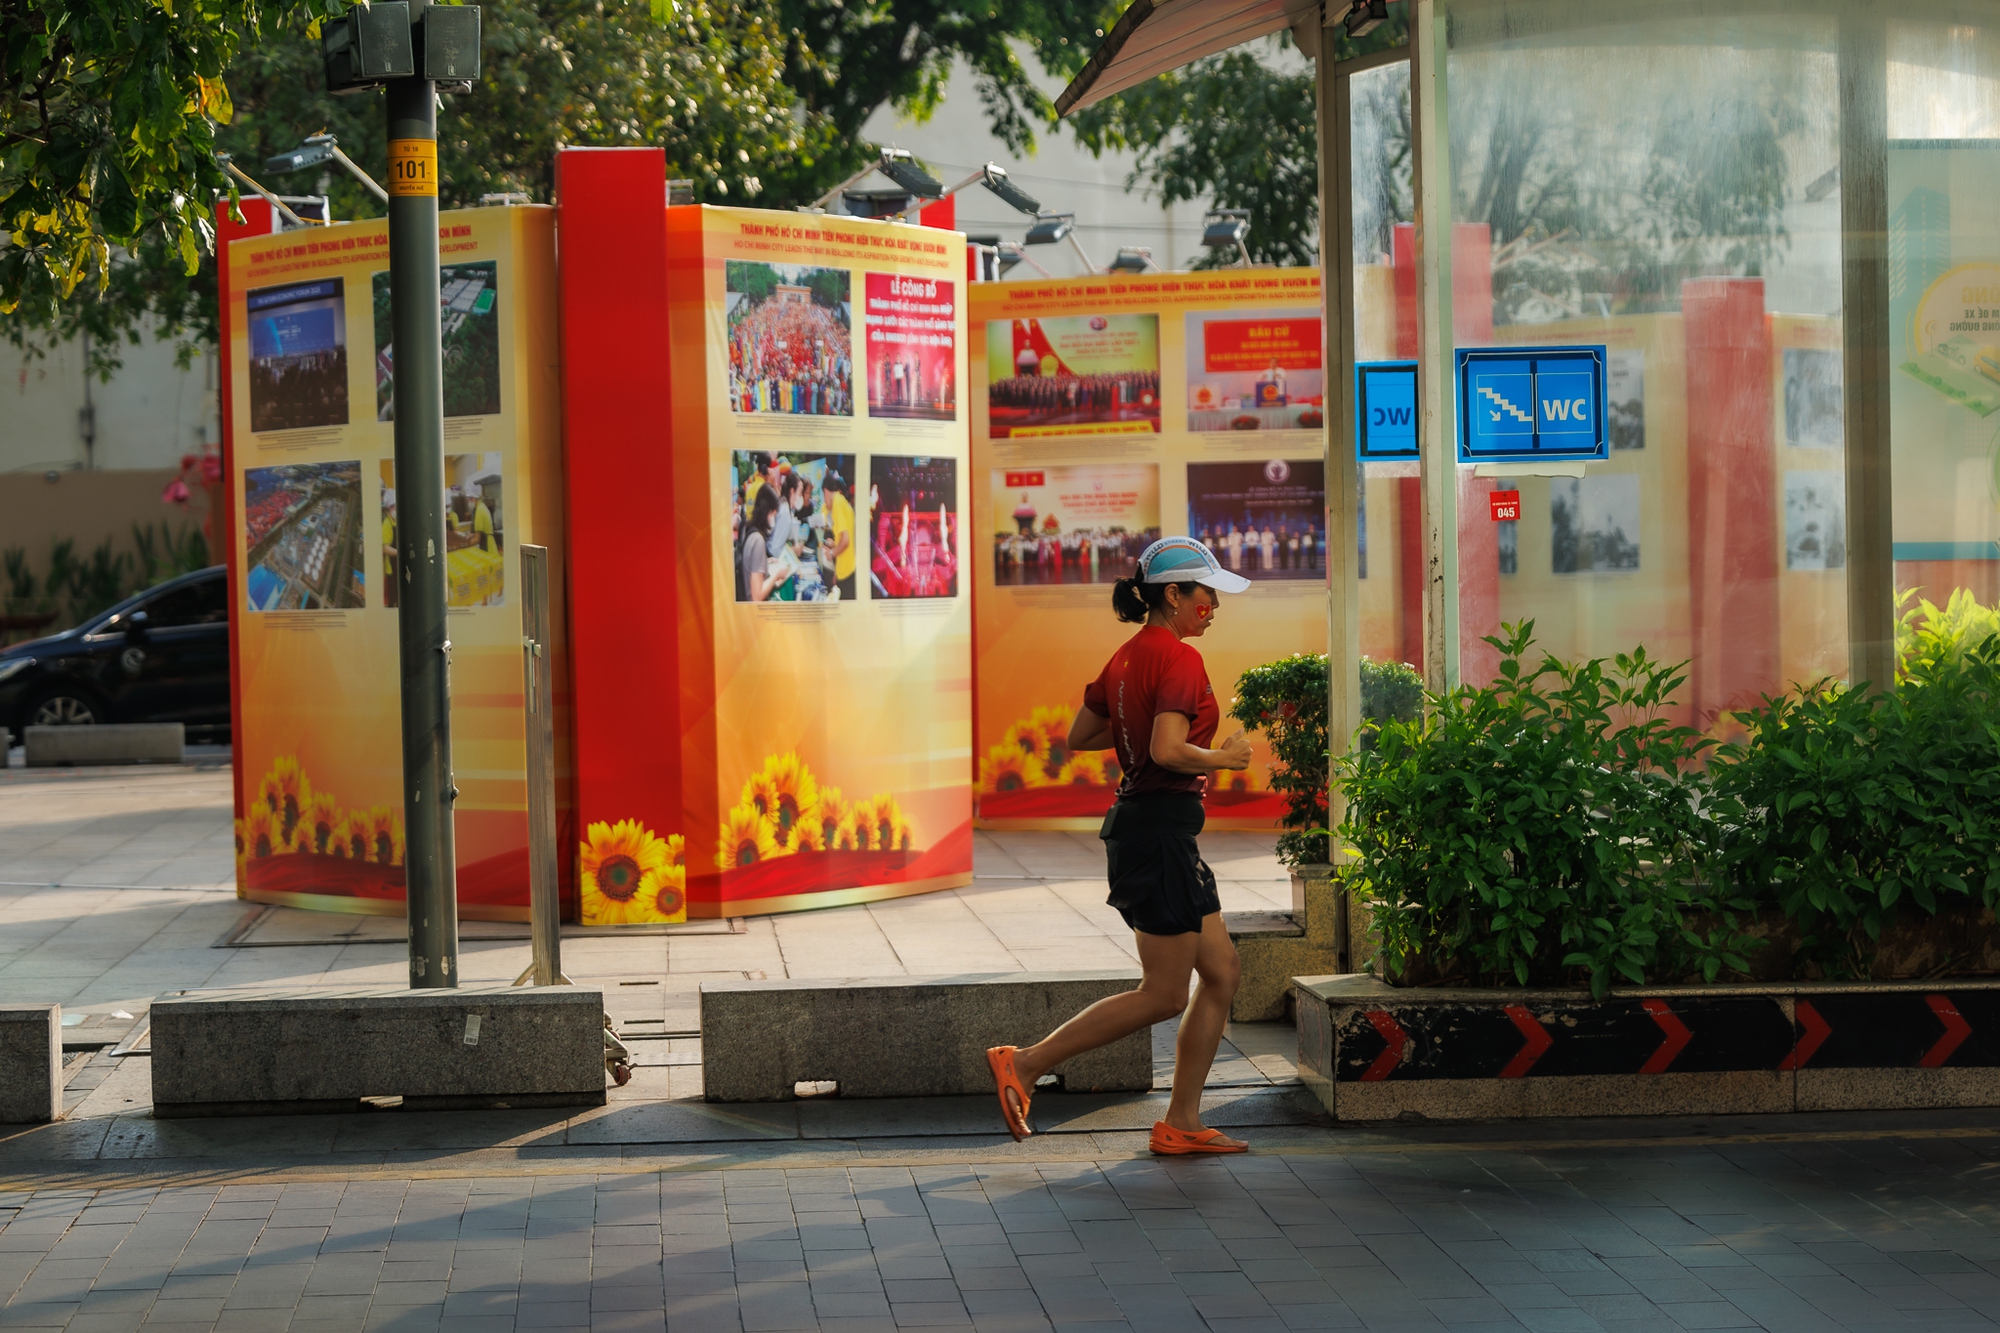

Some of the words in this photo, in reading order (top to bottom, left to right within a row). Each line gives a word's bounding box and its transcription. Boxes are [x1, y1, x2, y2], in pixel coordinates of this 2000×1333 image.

[396, 160, 425, 178] 101
[452, 224, 471, 237] MÌNH
[741, 222, 763, 235] THÀNH
[765, 223, 779, 237] PHỐ
[805, 229, 820, 239] MINH
[836, 232, 855, 244] PHONG
[439, 241, 478, 252] EVELOPMENT
[772, 243, 784, 251] CITY
[785, 244, 802, 253] LEADS
[804, 245, 813, 253] THE
[891, 275, 900, 295] LỄ
[902, 279, 924, 298] CÔNG
[1009, 288, 1035, 299] THÀNH
[1130, 282, 1158, 292] PHONG
[1543, 399, 1586, 420] WC
[1498, 508, 1515, 518] 045
